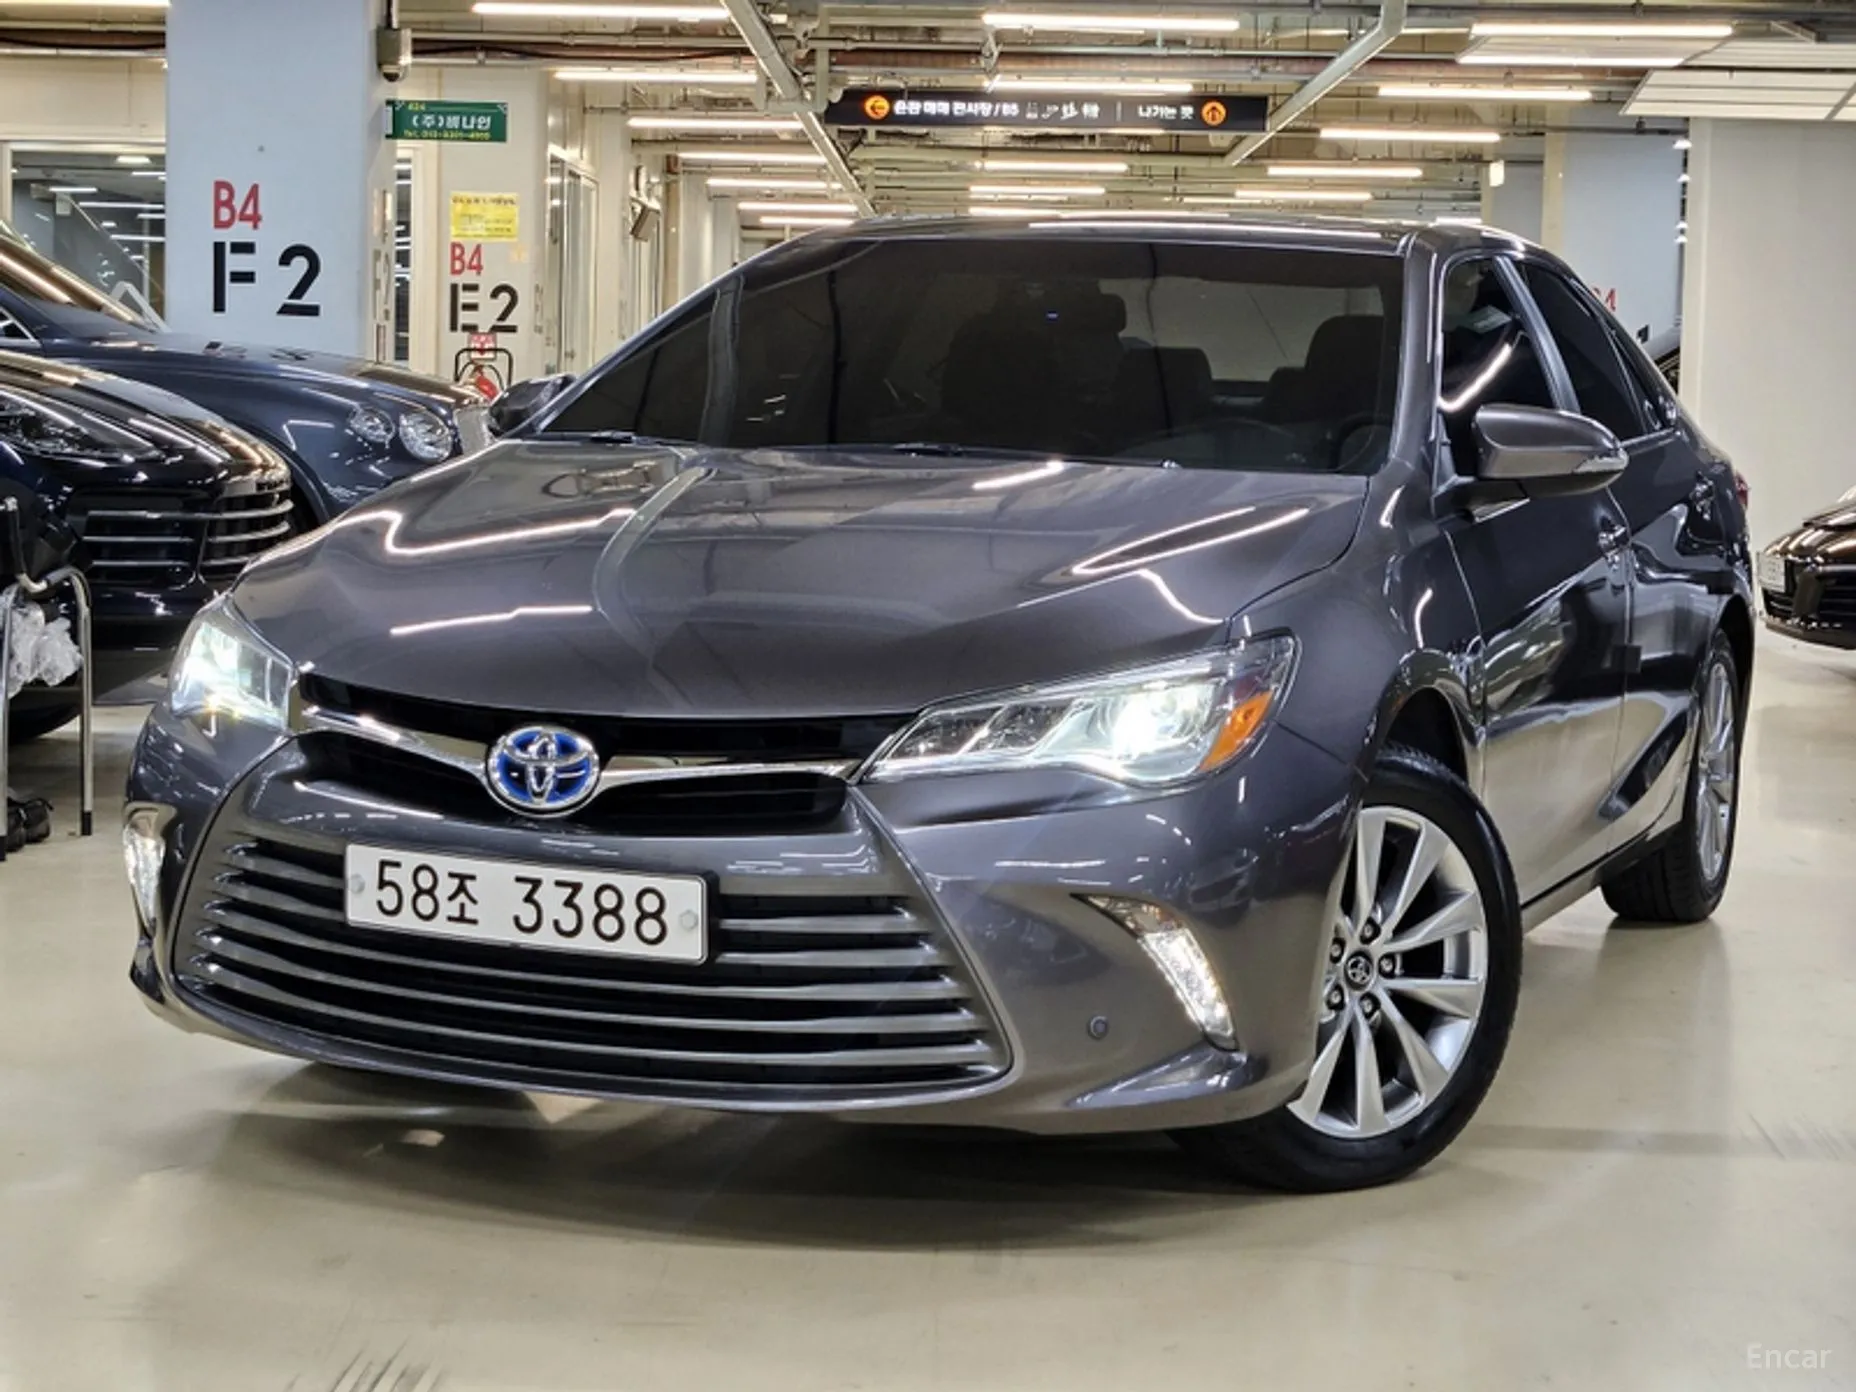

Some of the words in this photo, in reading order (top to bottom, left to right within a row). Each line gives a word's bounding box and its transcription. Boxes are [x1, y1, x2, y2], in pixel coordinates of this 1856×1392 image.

[1138, 104, 1177, 119] 나가는
[1181, 104, 1195, 120] 곳
[213, 180, 262, 230] B4
[450, 241, 483, 276] B4
[450, 283, 518, 332] E2
[376, 860, 479, 926] 58조
[513, 875, 668, 946] 3388
